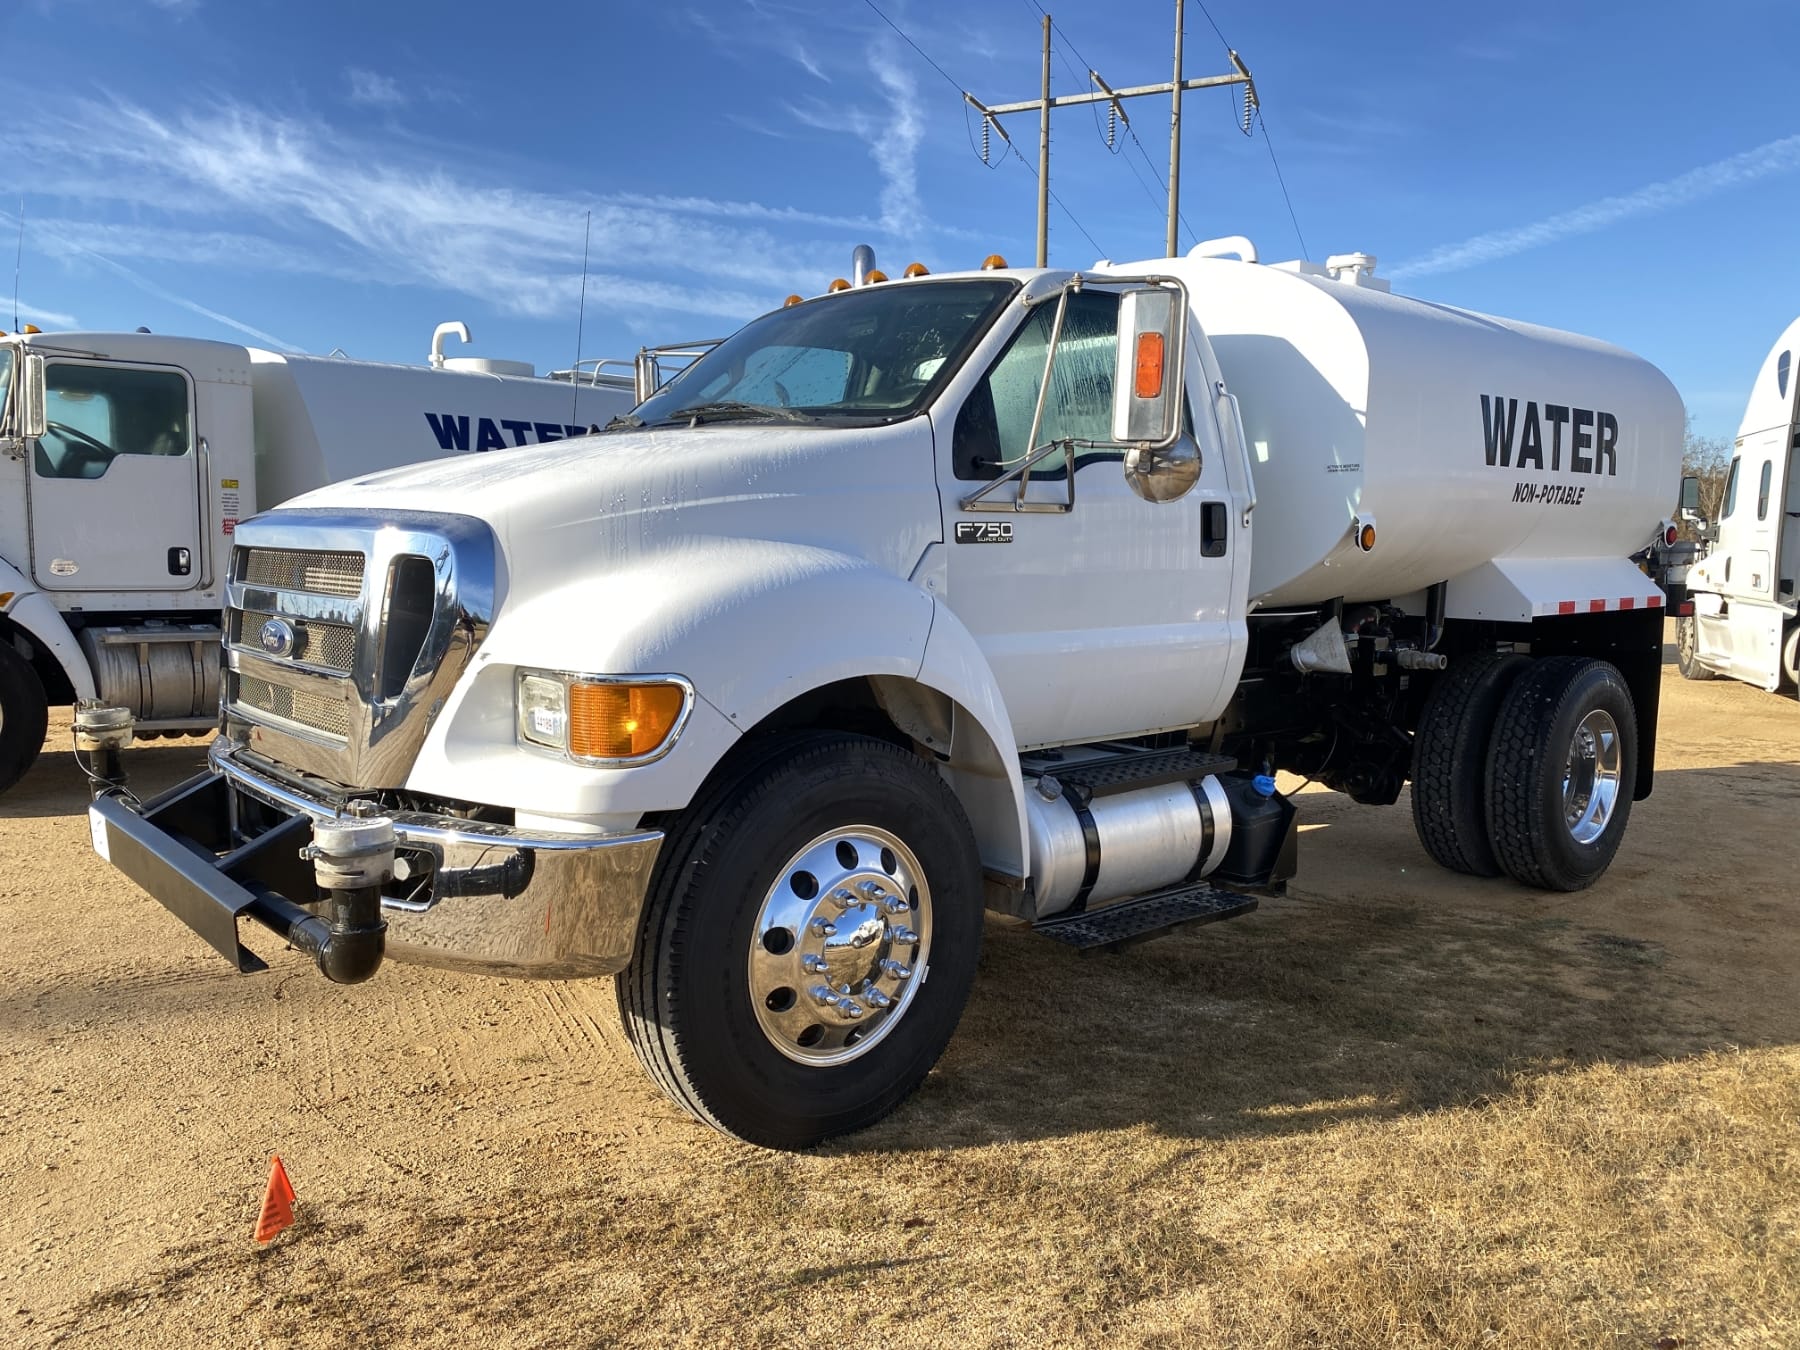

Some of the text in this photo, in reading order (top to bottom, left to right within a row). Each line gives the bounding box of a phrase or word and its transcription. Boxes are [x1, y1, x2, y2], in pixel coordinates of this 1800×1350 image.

[423, 412, 591, 452] WATE
[1479, 394, 1619, 476] WATER
[1511, 482, 1586, 506] NON-POTABLE
